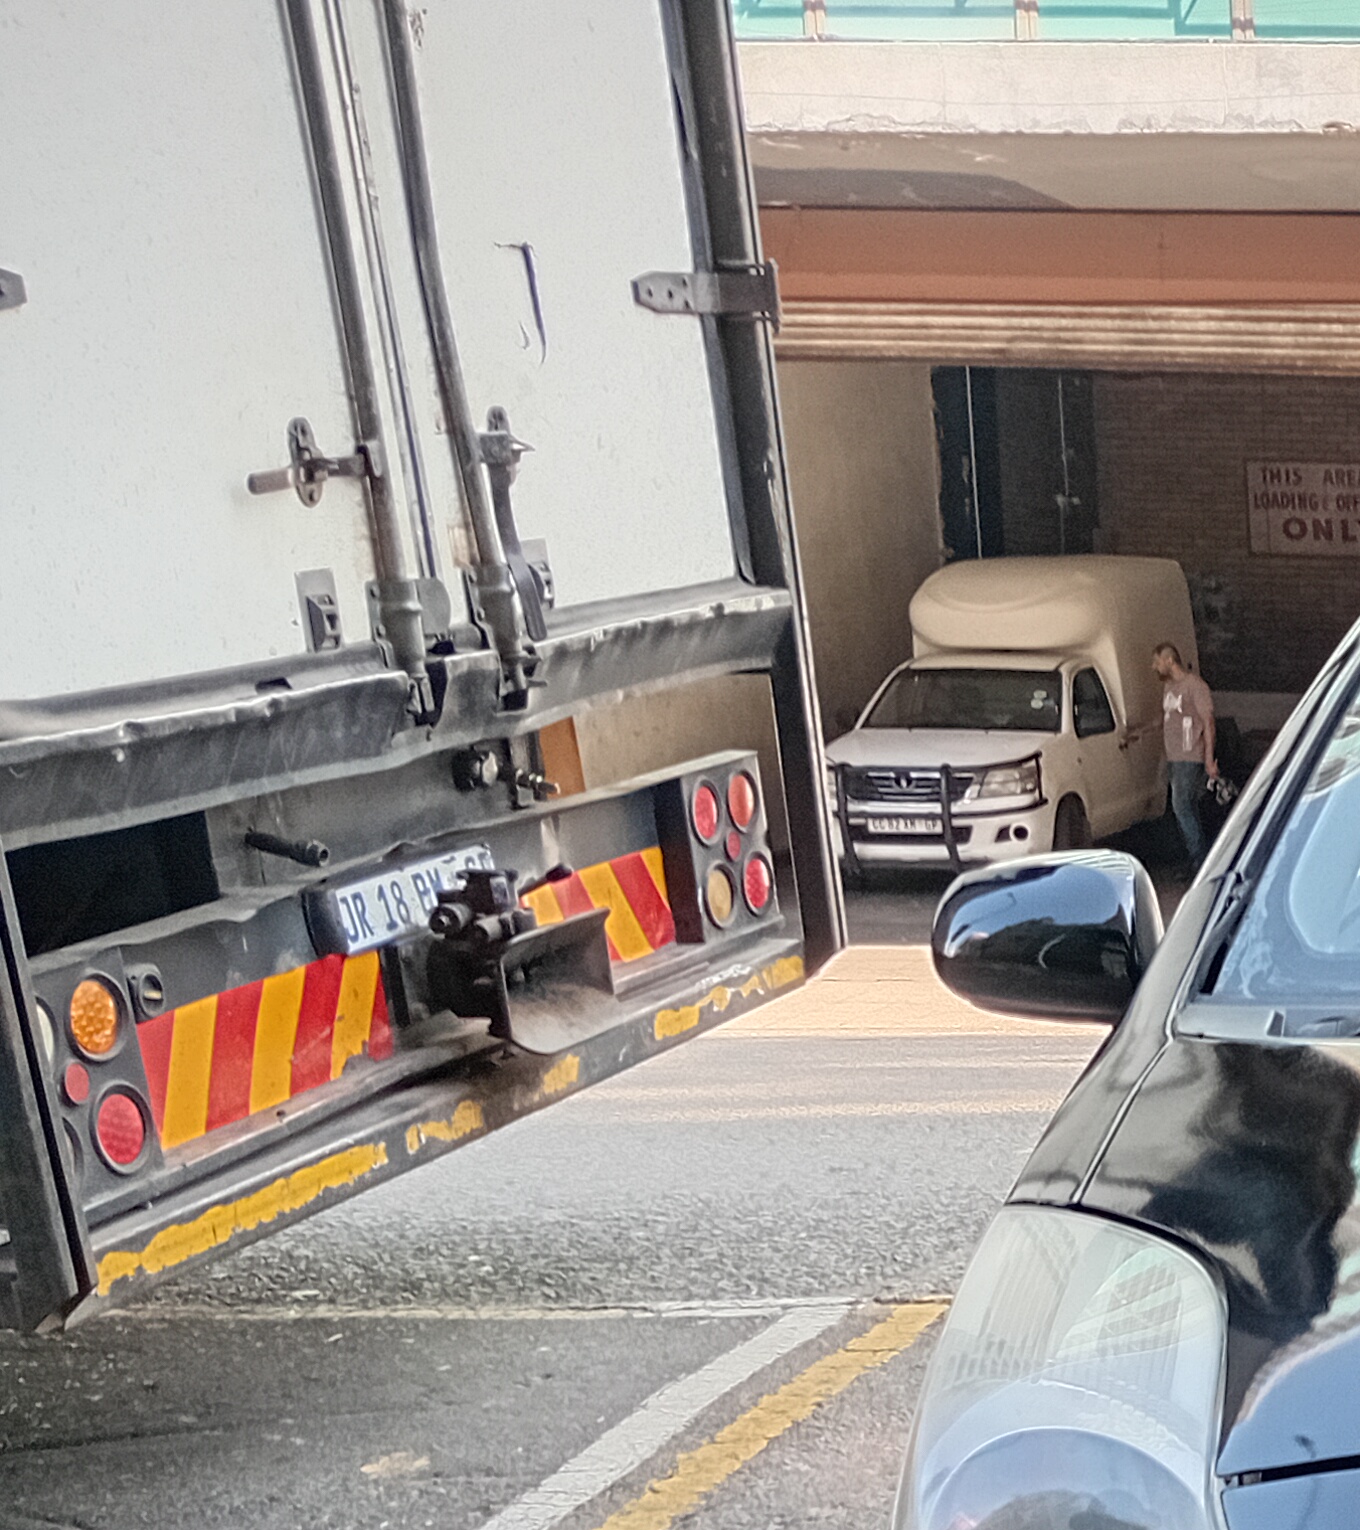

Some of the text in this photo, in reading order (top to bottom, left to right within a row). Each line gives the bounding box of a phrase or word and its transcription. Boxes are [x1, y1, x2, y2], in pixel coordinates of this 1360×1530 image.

[1260, 467, 1303, 486] THIS
[1253, 491, 1319, 512] LOADING
[376, 880, 411, 932] 18
